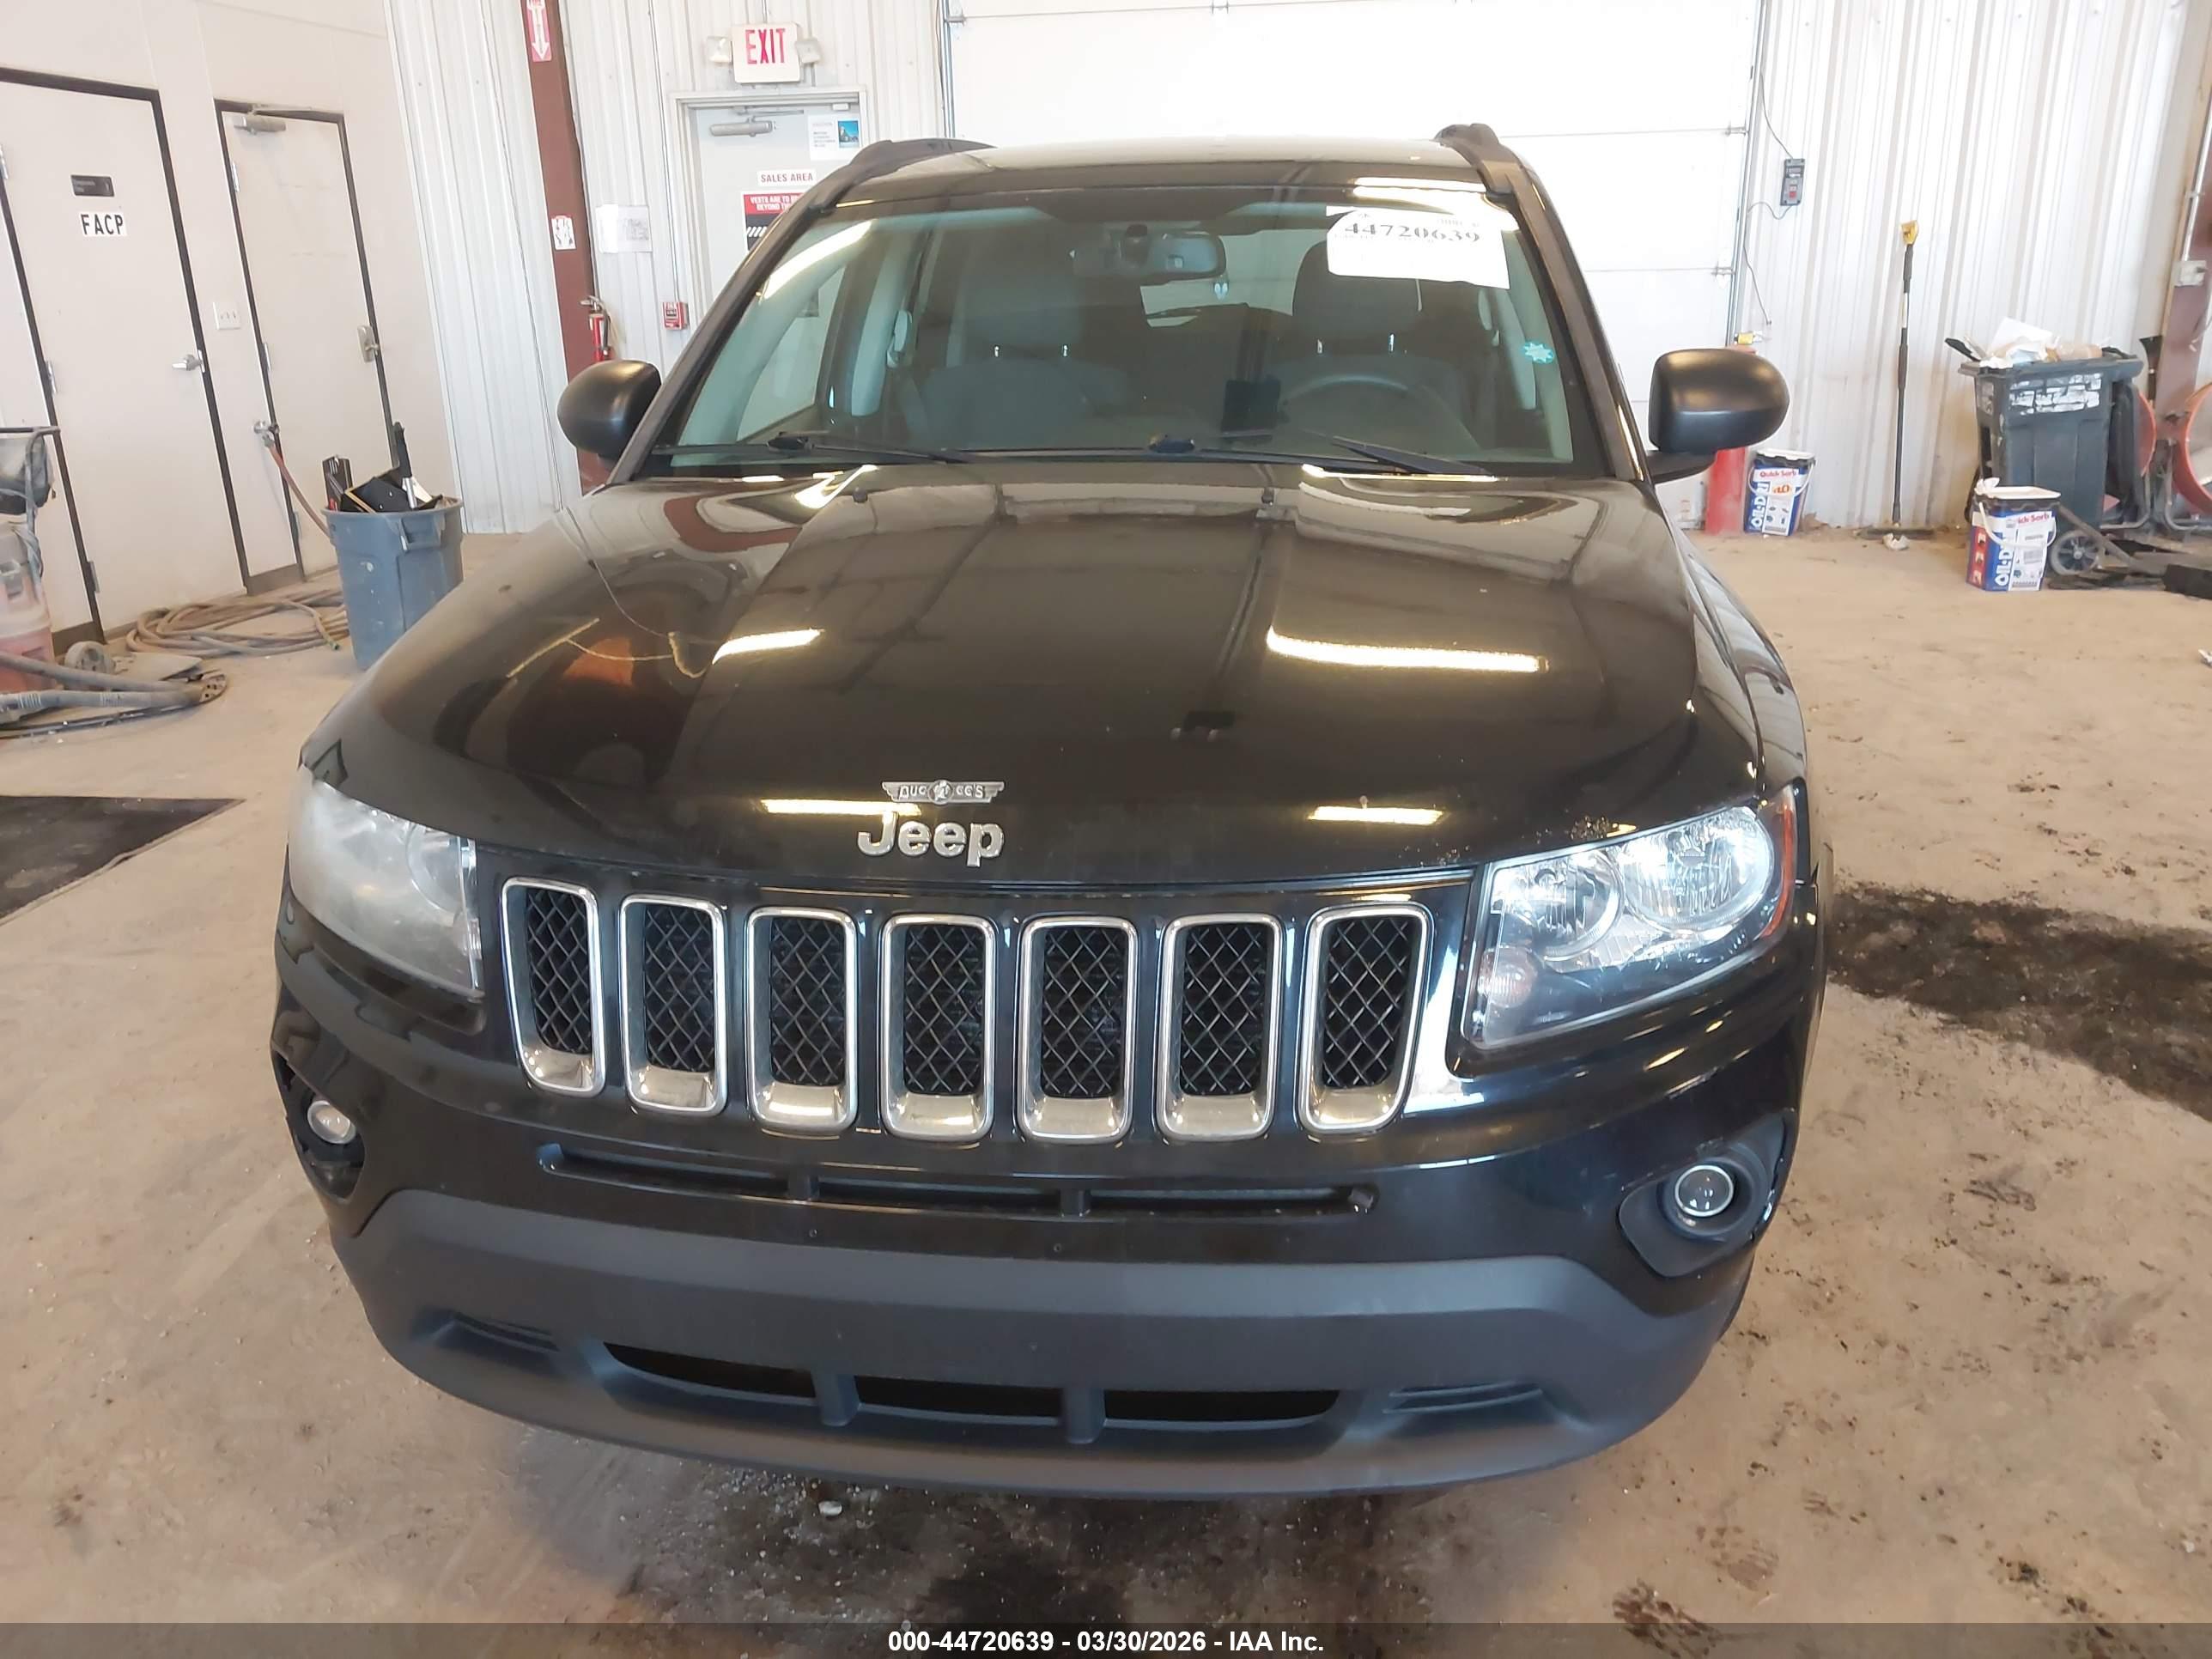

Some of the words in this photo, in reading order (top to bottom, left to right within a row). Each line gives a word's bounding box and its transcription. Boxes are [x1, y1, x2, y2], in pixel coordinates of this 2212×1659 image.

[744, 27, 786, 64] EXIT
[761, 173, 787, 183] SALES
[791, 173, 813, 181] AREA
[81, 214, 124, 235] FACP
[1345, 223, 1480, 242] 44720639
[857, 810, 1005, 867] Jeep
